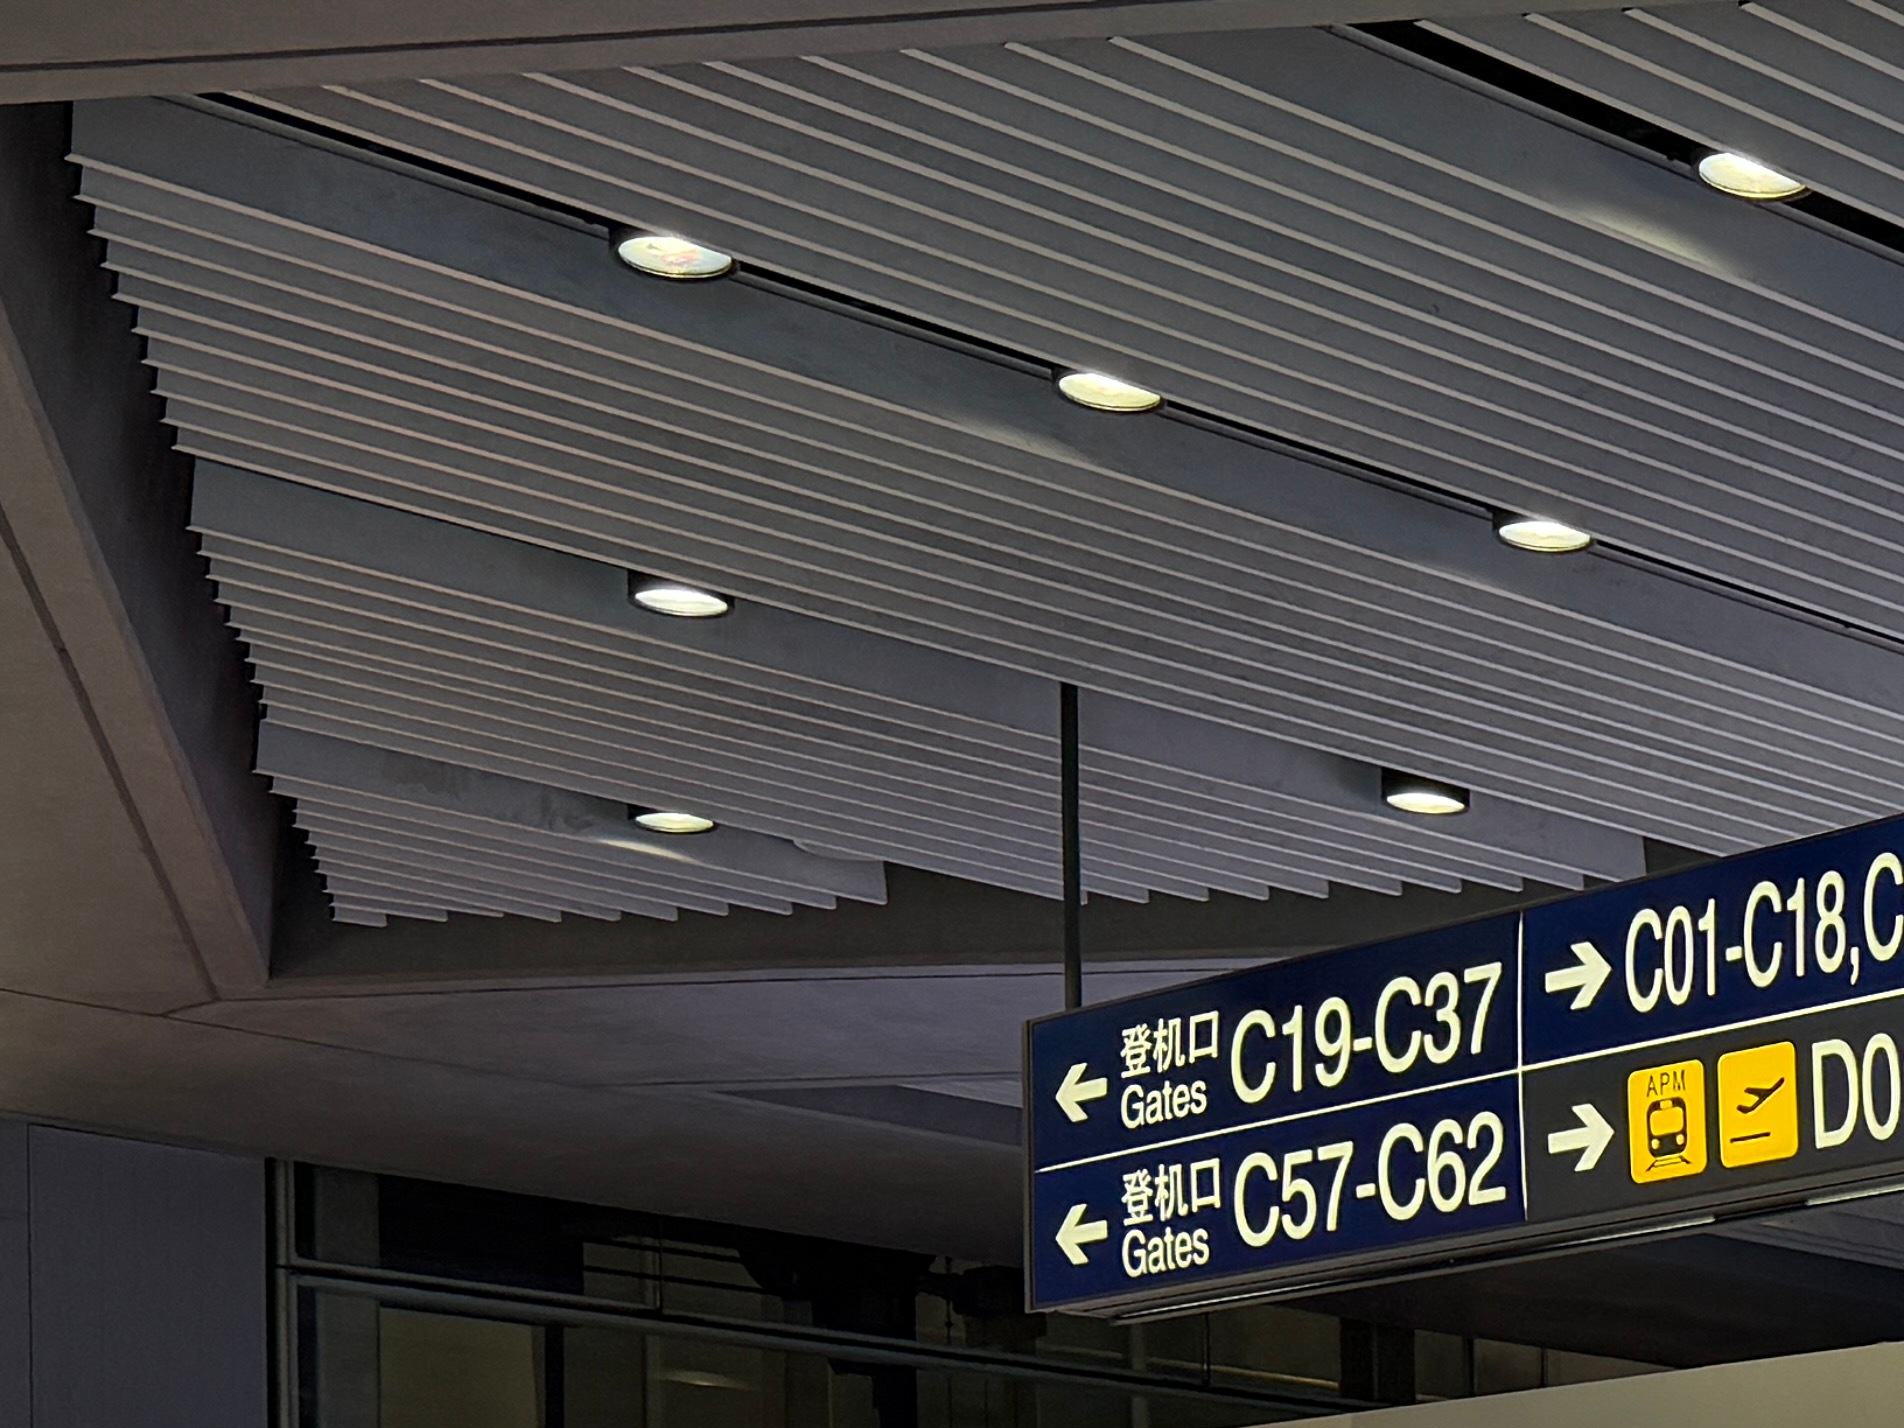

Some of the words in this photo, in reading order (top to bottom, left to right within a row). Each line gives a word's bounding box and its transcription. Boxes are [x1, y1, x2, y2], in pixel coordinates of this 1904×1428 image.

[1121, 1008, 1220, 1080] 登机口
[1231, 964, 1503, 1106] C19-C37
[1120, 1075, 1207, 1129] Gates
[1647, 1069, 1686, 1097] APM
[1122, 1153, 1222, 1227] 登机口
[1234, 1110, 1507, 1248] C57-C62
[1121, 1225, 1209, 1277] Gates
